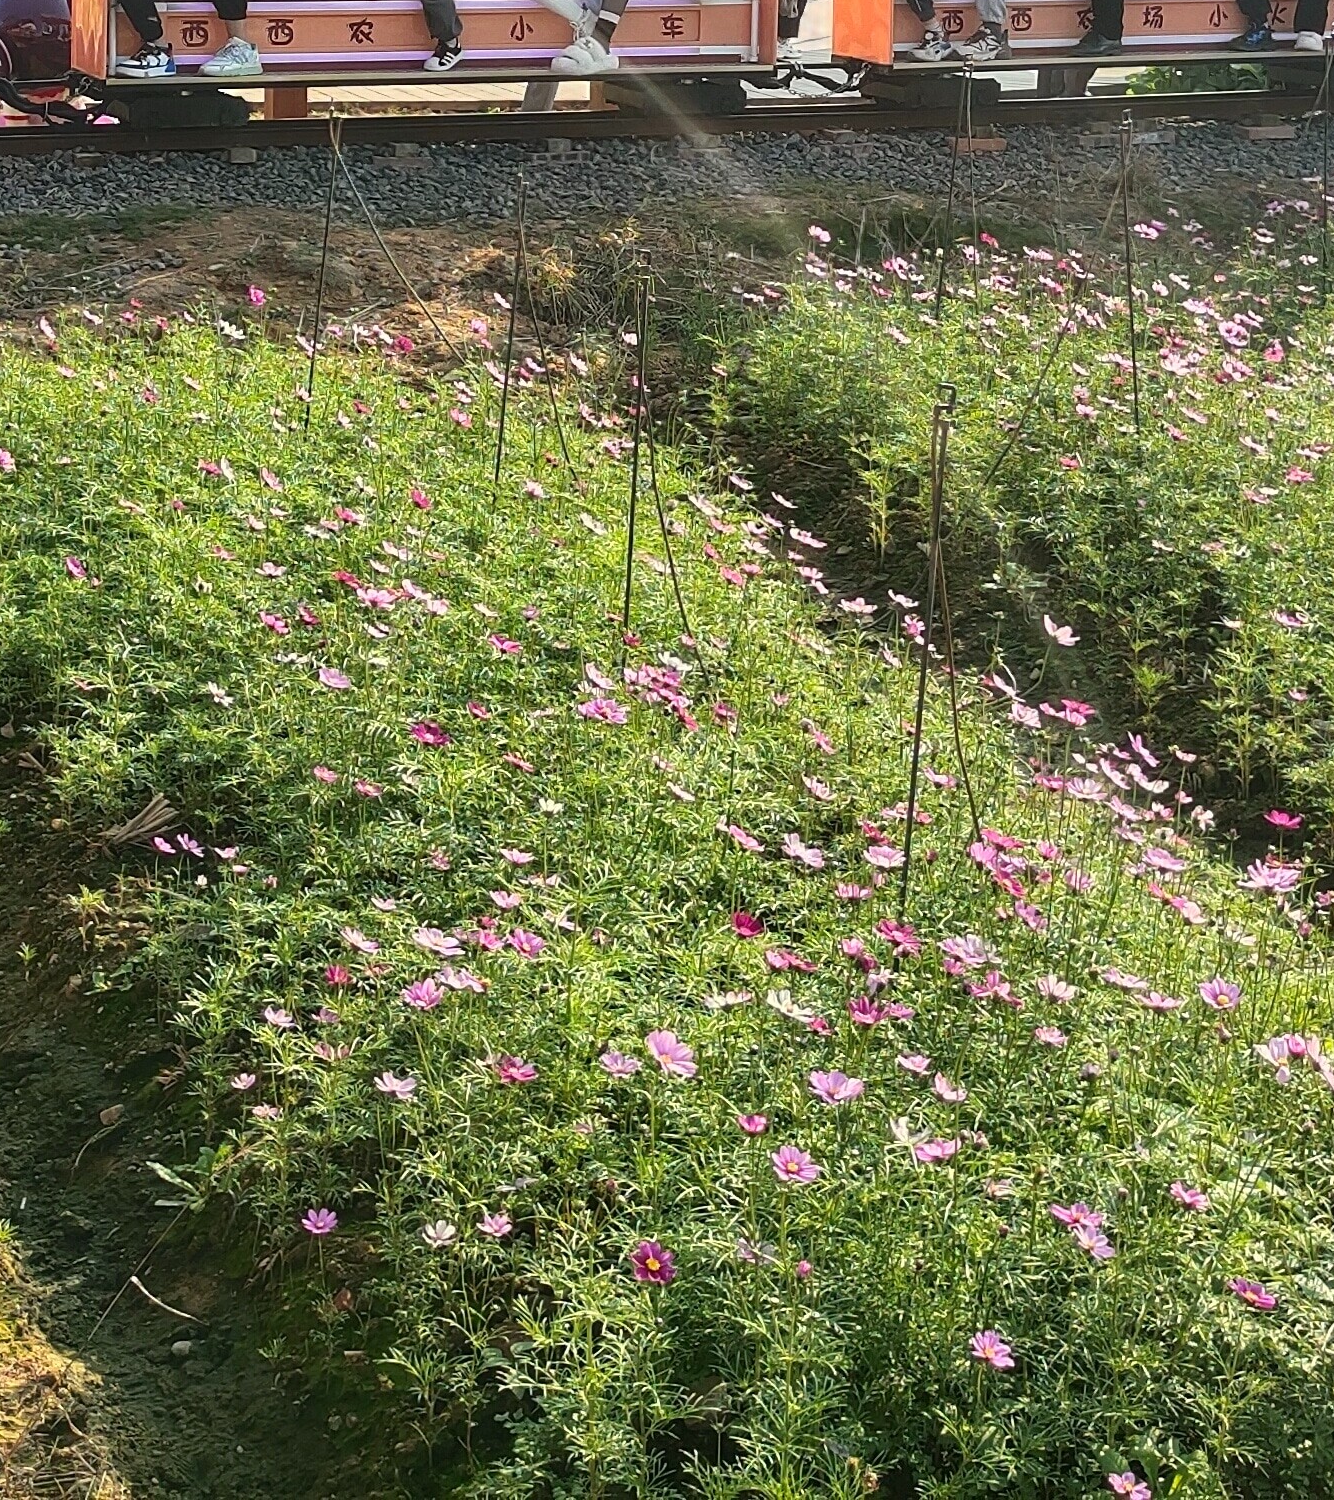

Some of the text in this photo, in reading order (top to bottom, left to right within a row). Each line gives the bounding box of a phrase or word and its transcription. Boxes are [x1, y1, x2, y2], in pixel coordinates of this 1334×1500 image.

[181, 15, 684, 47] 西西农小车
